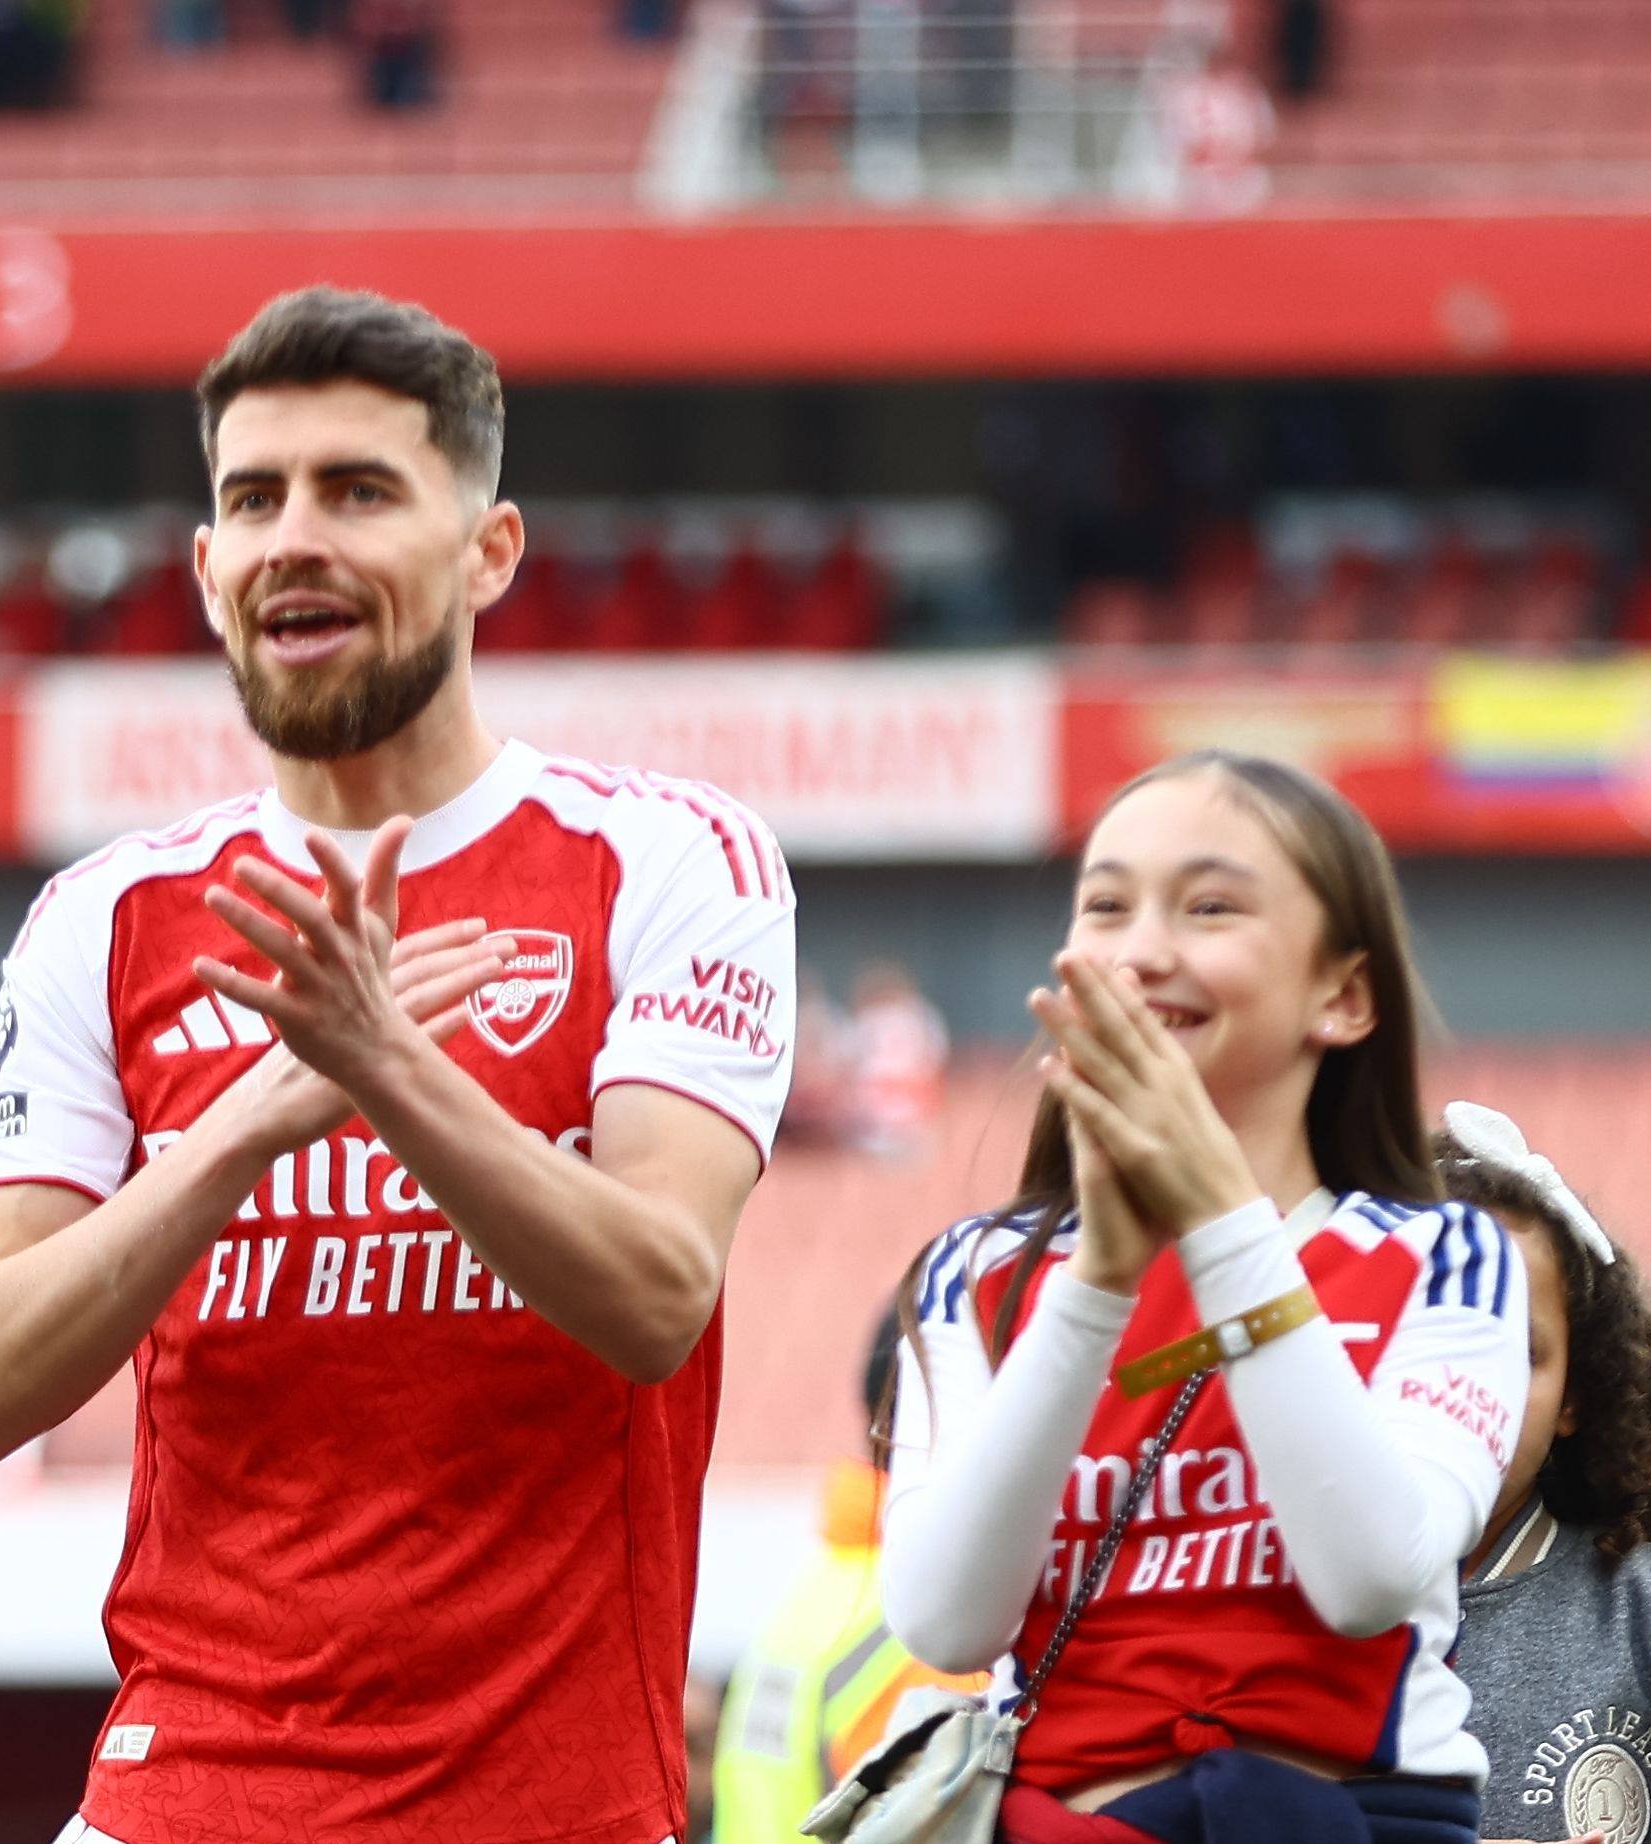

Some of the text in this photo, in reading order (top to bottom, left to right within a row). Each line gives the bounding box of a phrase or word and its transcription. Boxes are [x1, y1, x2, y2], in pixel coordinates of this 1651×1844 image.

[690, 953, 777, 1020] VISIT
[197, 1237, 288, 1322] FLY
[1523, 1707, 1599, 1805] SPORT
